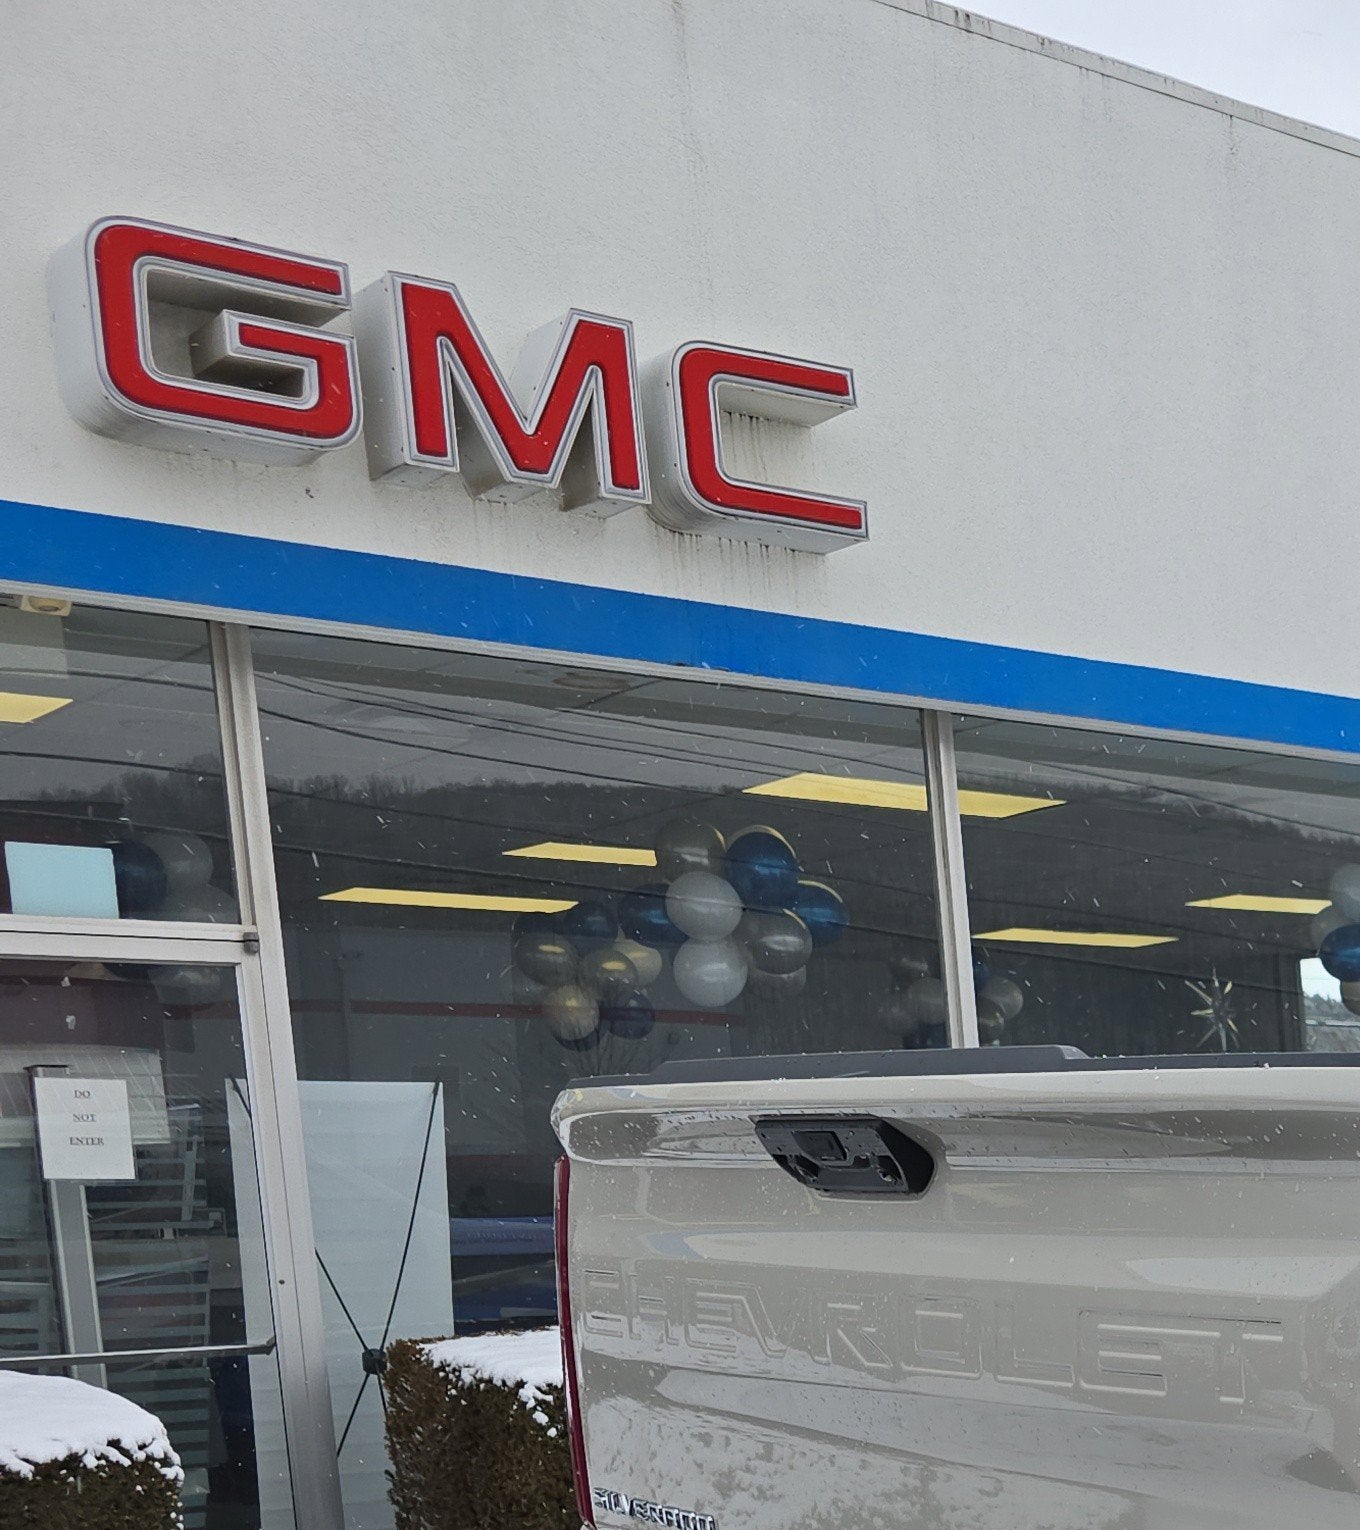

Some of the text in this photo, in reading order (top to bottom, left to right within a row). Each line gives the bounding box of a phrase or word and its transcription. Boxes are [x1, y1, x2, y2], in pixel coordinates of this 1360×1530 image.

[80, 215, 870, 545] GMC
[74, 1089, 91, 1099] DO
[72, 1113, 97, 1123] NOT
[69, 1136, 105, 1146] ENTER
[580, 1263, 1284, 1403] CHEVROLET
